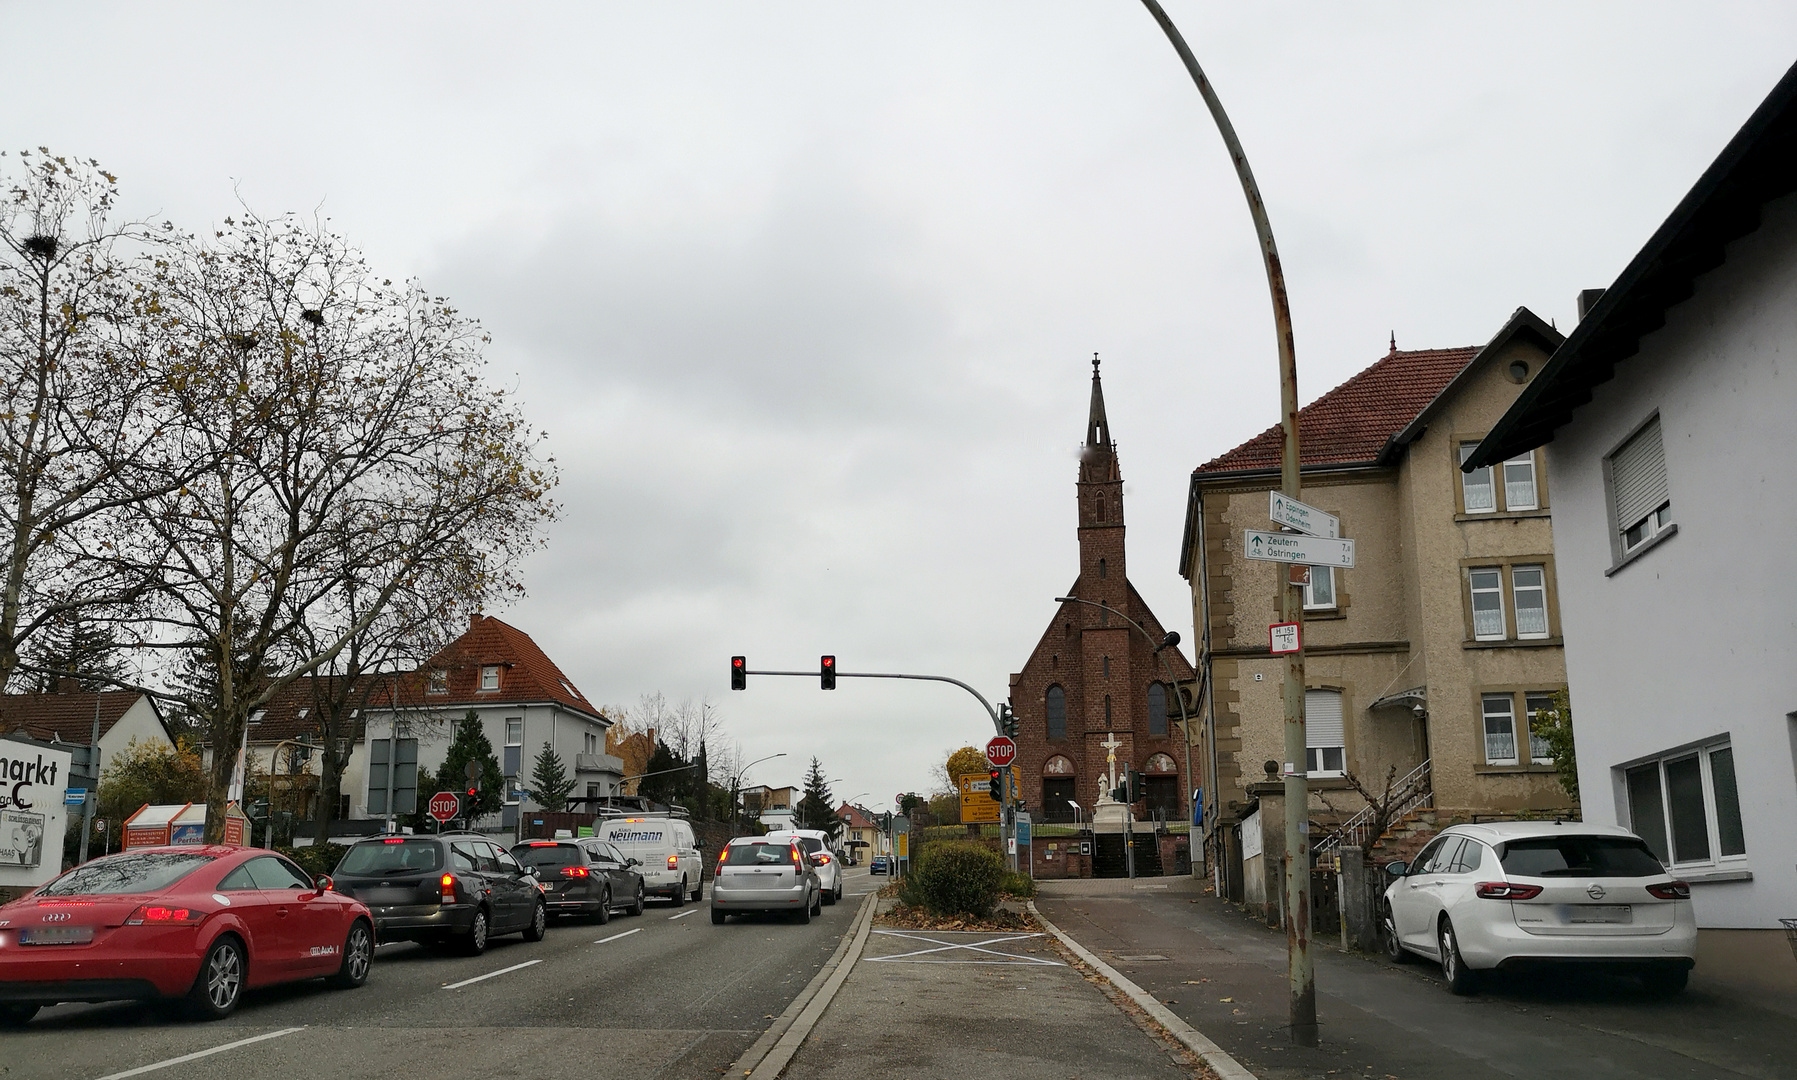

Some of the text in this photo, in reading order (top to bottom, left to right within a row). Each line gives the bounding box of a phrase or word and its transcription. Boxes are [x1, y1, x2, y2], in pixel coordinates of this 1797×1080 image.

[1285, 501, 1310, 518] Eppingen
[1285, 512, 1311, 530] Odenheim
[1267, 536, 1299, 547] Zeutern
[1267, 547, 1306, 560] Östringen
[988, 745, 1013, 758] STOP
[432, 800, 456, 812] STOP
[609, 831, 663, 841] Neumann
